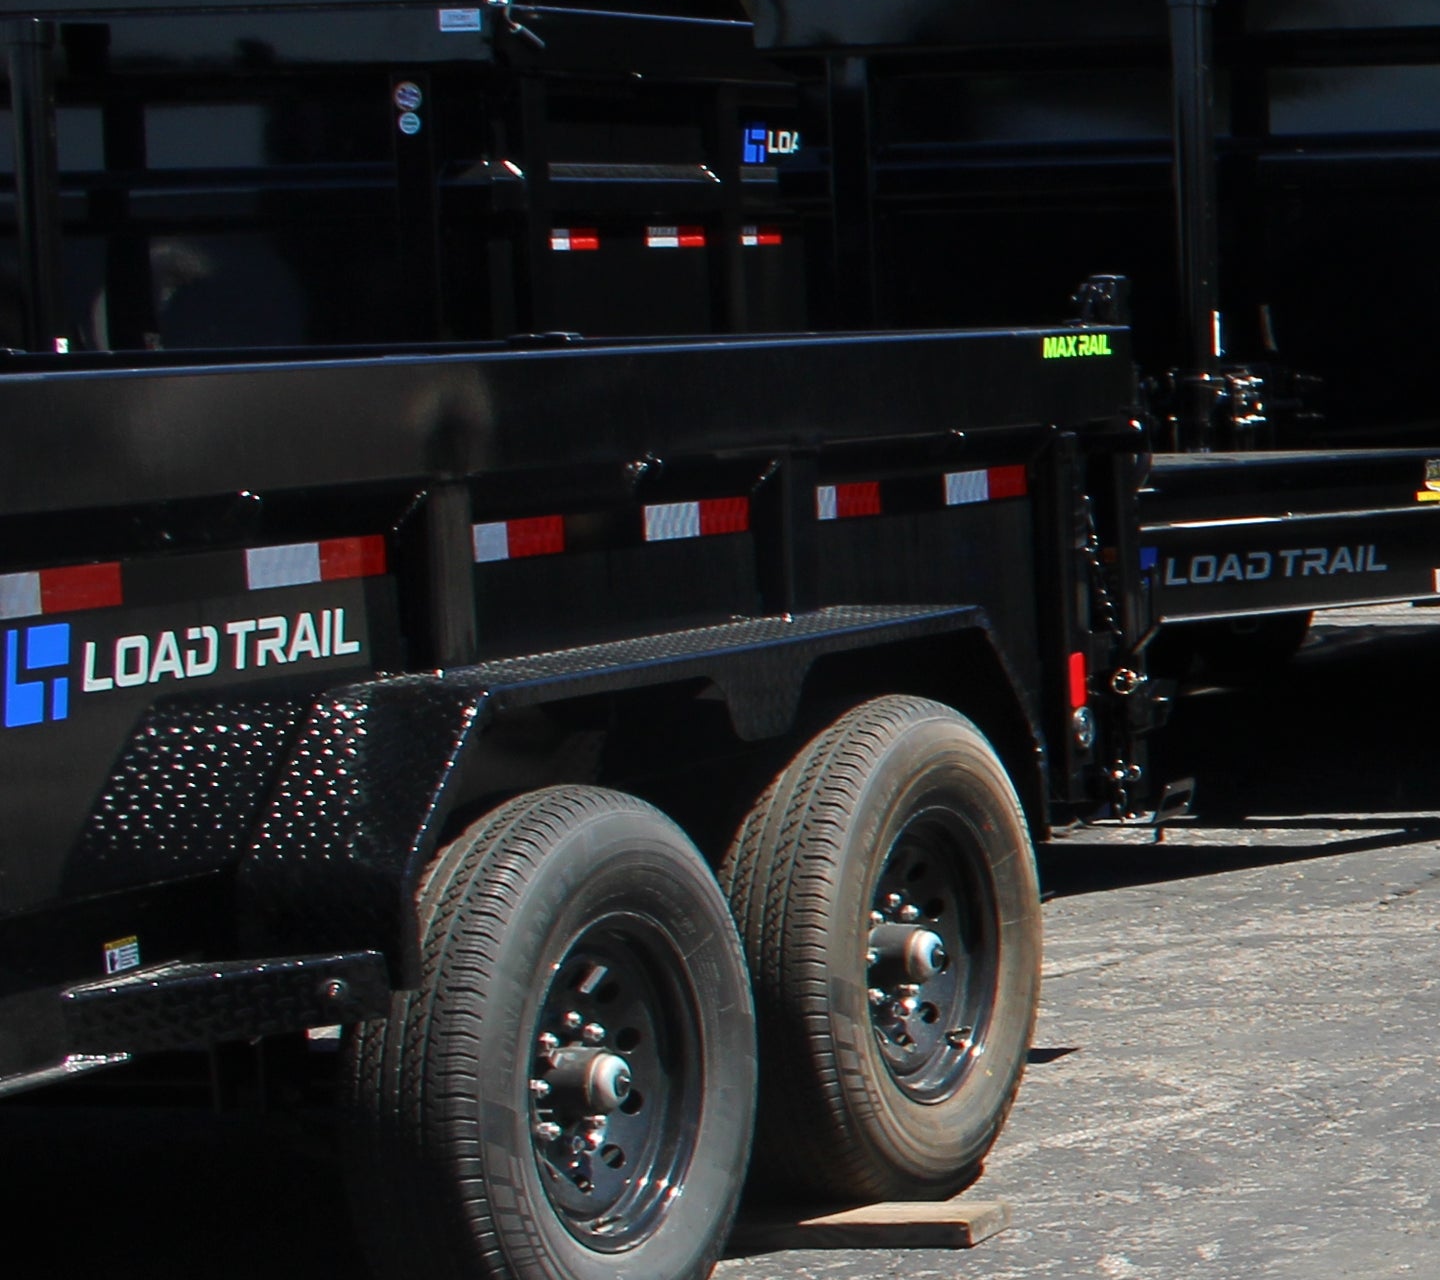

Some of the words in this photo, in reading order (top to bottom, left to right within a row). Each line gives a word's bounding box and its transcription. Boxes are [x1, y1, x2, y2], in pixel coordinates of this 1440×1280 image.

[768, 130, 799, 153] LOA
[1043, 335, 1077, 359] MAX
[1078, 334, 1112, 357] RAIL
[1165, 551, 1271, 585] LOAD
[1280, 544, 1387, 578] TRAIL
[82, 625, 219, 692] LOAD
[226, 607, 361, 670] TRAIL
